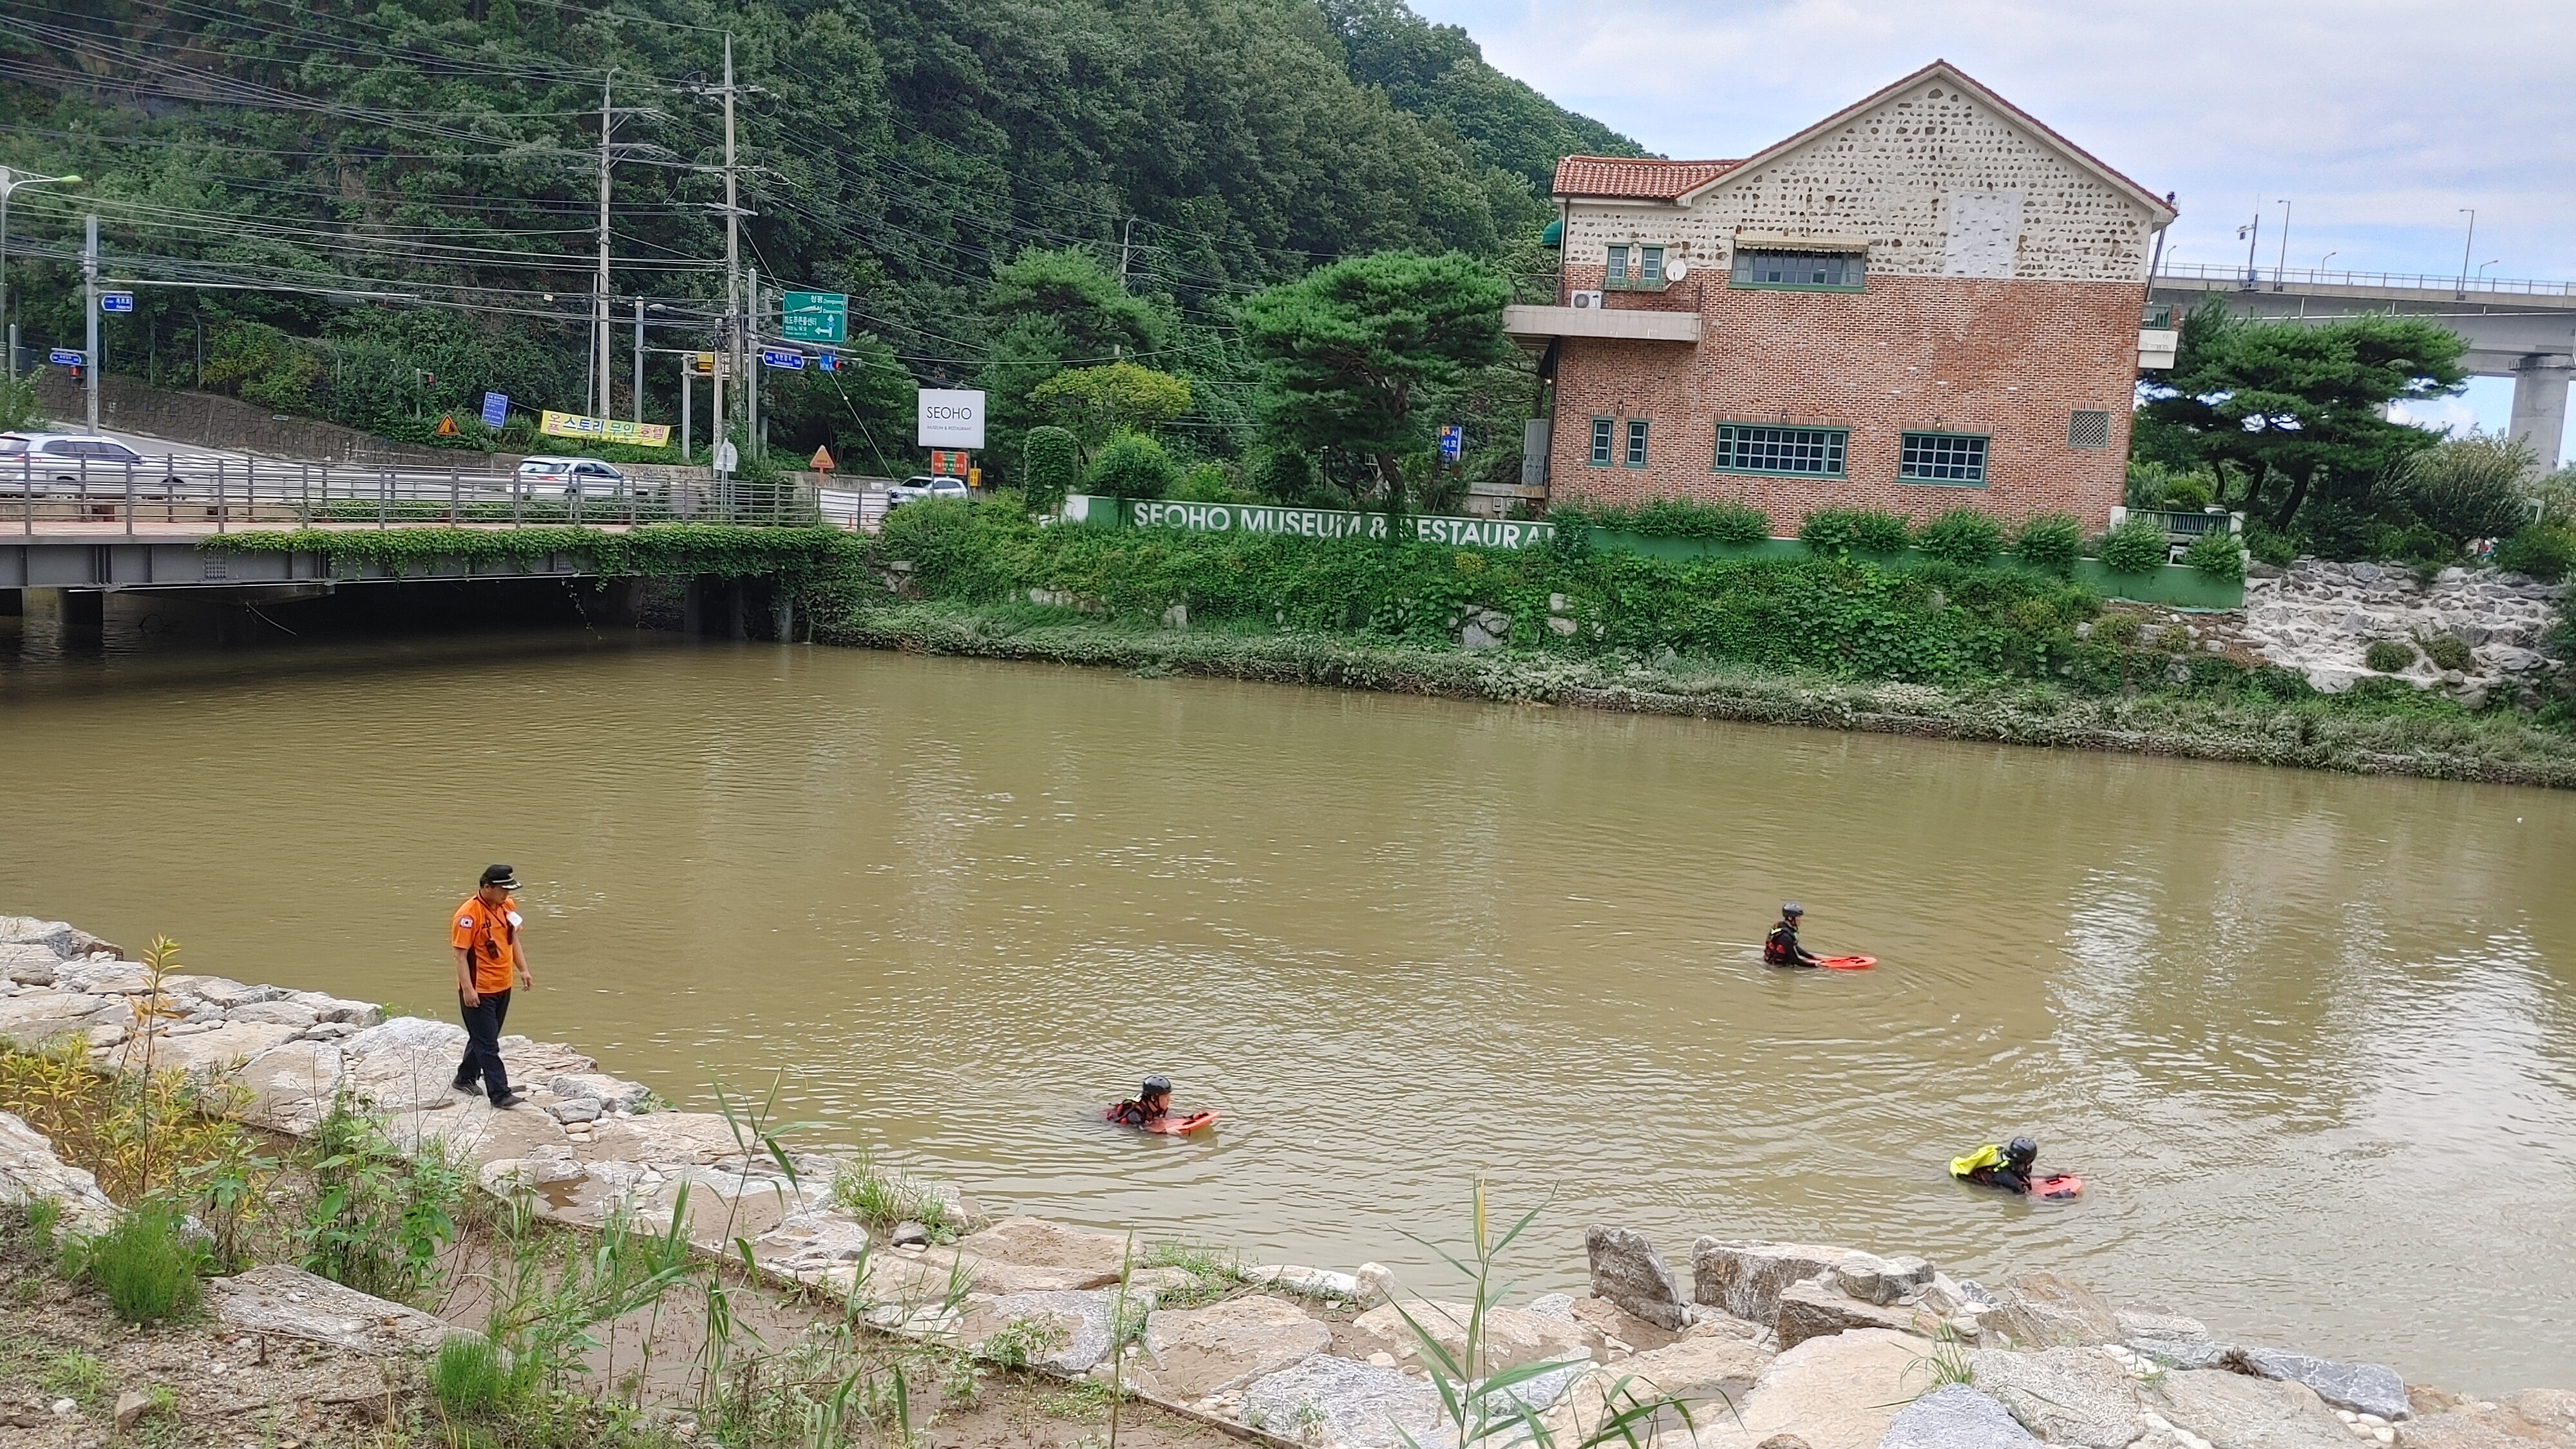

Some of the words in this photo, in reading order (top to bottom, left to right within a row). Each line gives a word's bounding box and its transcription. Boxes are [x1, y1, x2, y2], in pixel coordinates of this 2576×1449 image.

[547, 413, 560, 433] 오픈
[927, 406, 972, 420] SEOHO
[562, 417, 605, 435] 스토리
[609, 422, 635, 438] 무인
[638, 424, 665, 440] 호텔
[1133, 502, 1231, 532] SEOHO
[1240, 509, 1361, 539] MUSEUM
[1368, 516, 1388, 539] &
